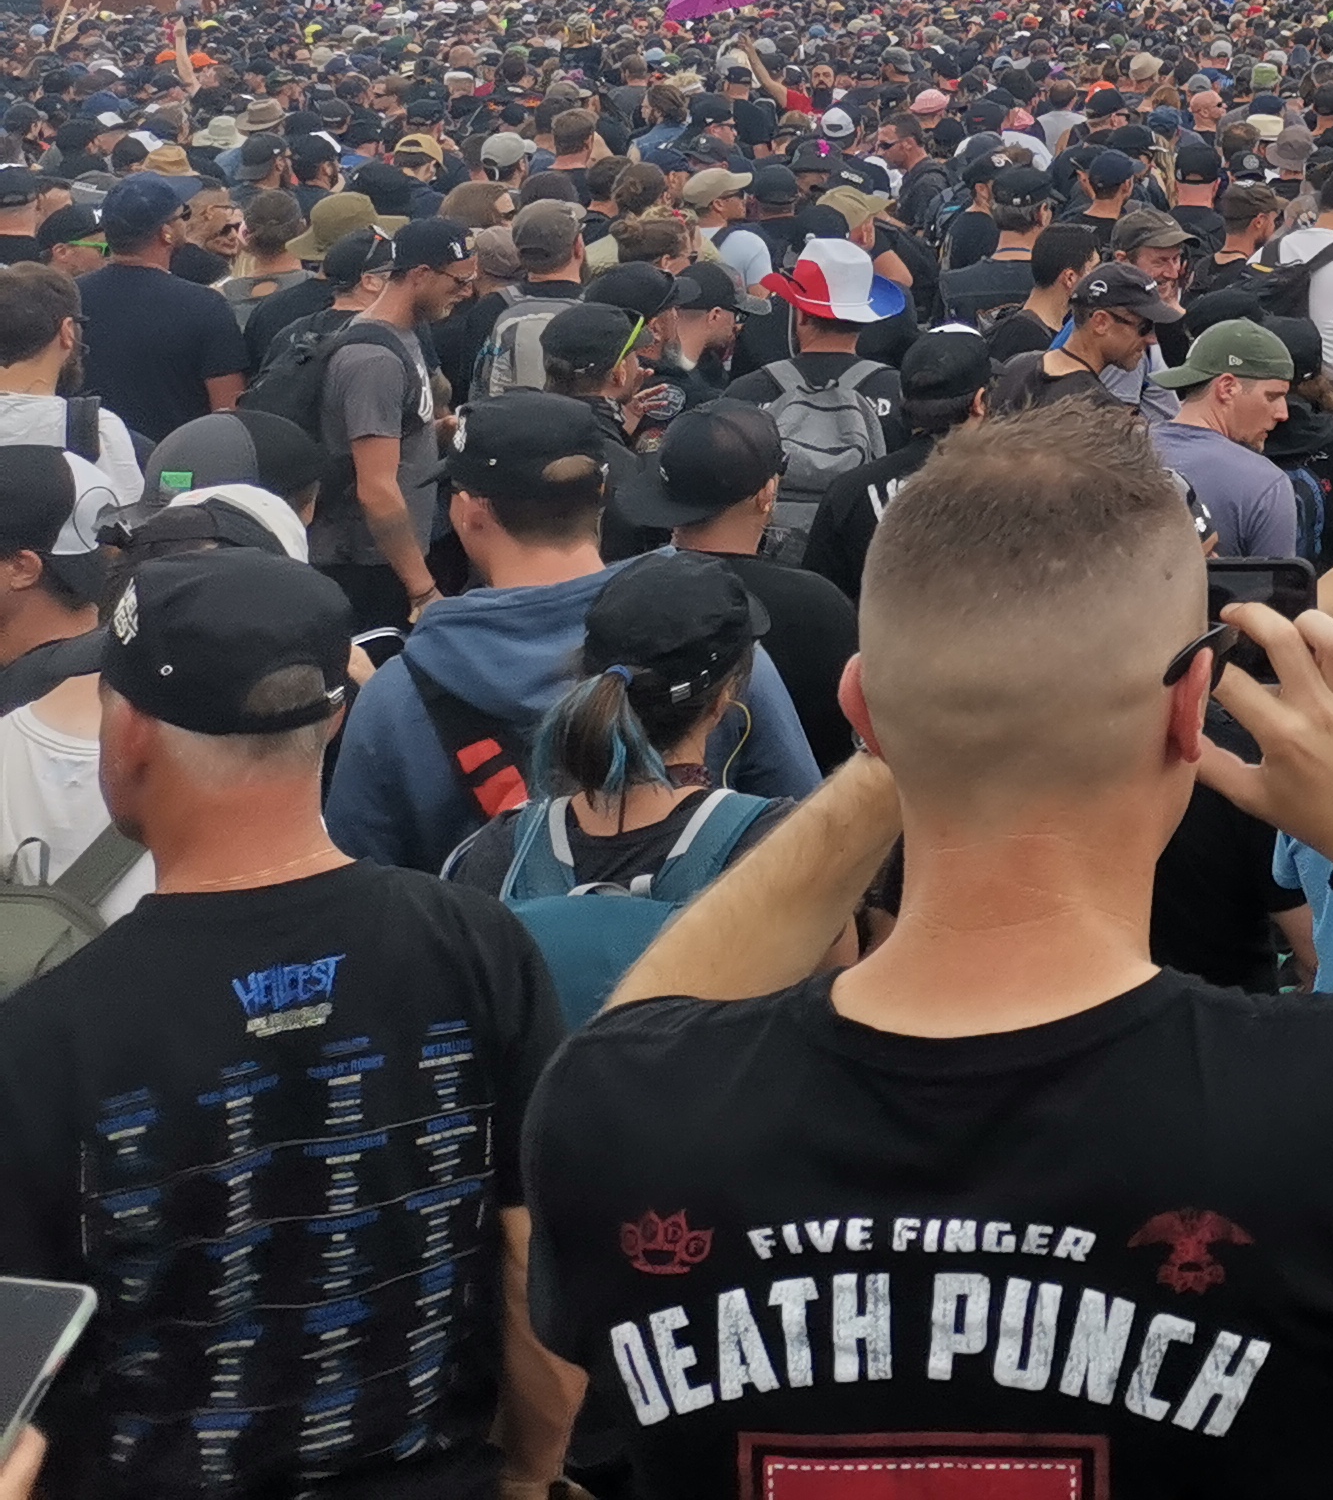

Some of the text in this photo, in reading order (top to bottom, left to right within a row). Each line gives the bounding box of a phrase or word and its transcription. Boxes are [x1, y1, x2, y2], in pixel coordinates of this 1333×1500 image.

[747, 1217, 1097, 1262] FIVE FINGER
[610, 1272, 1272, 1437] DEATH PUNCH
